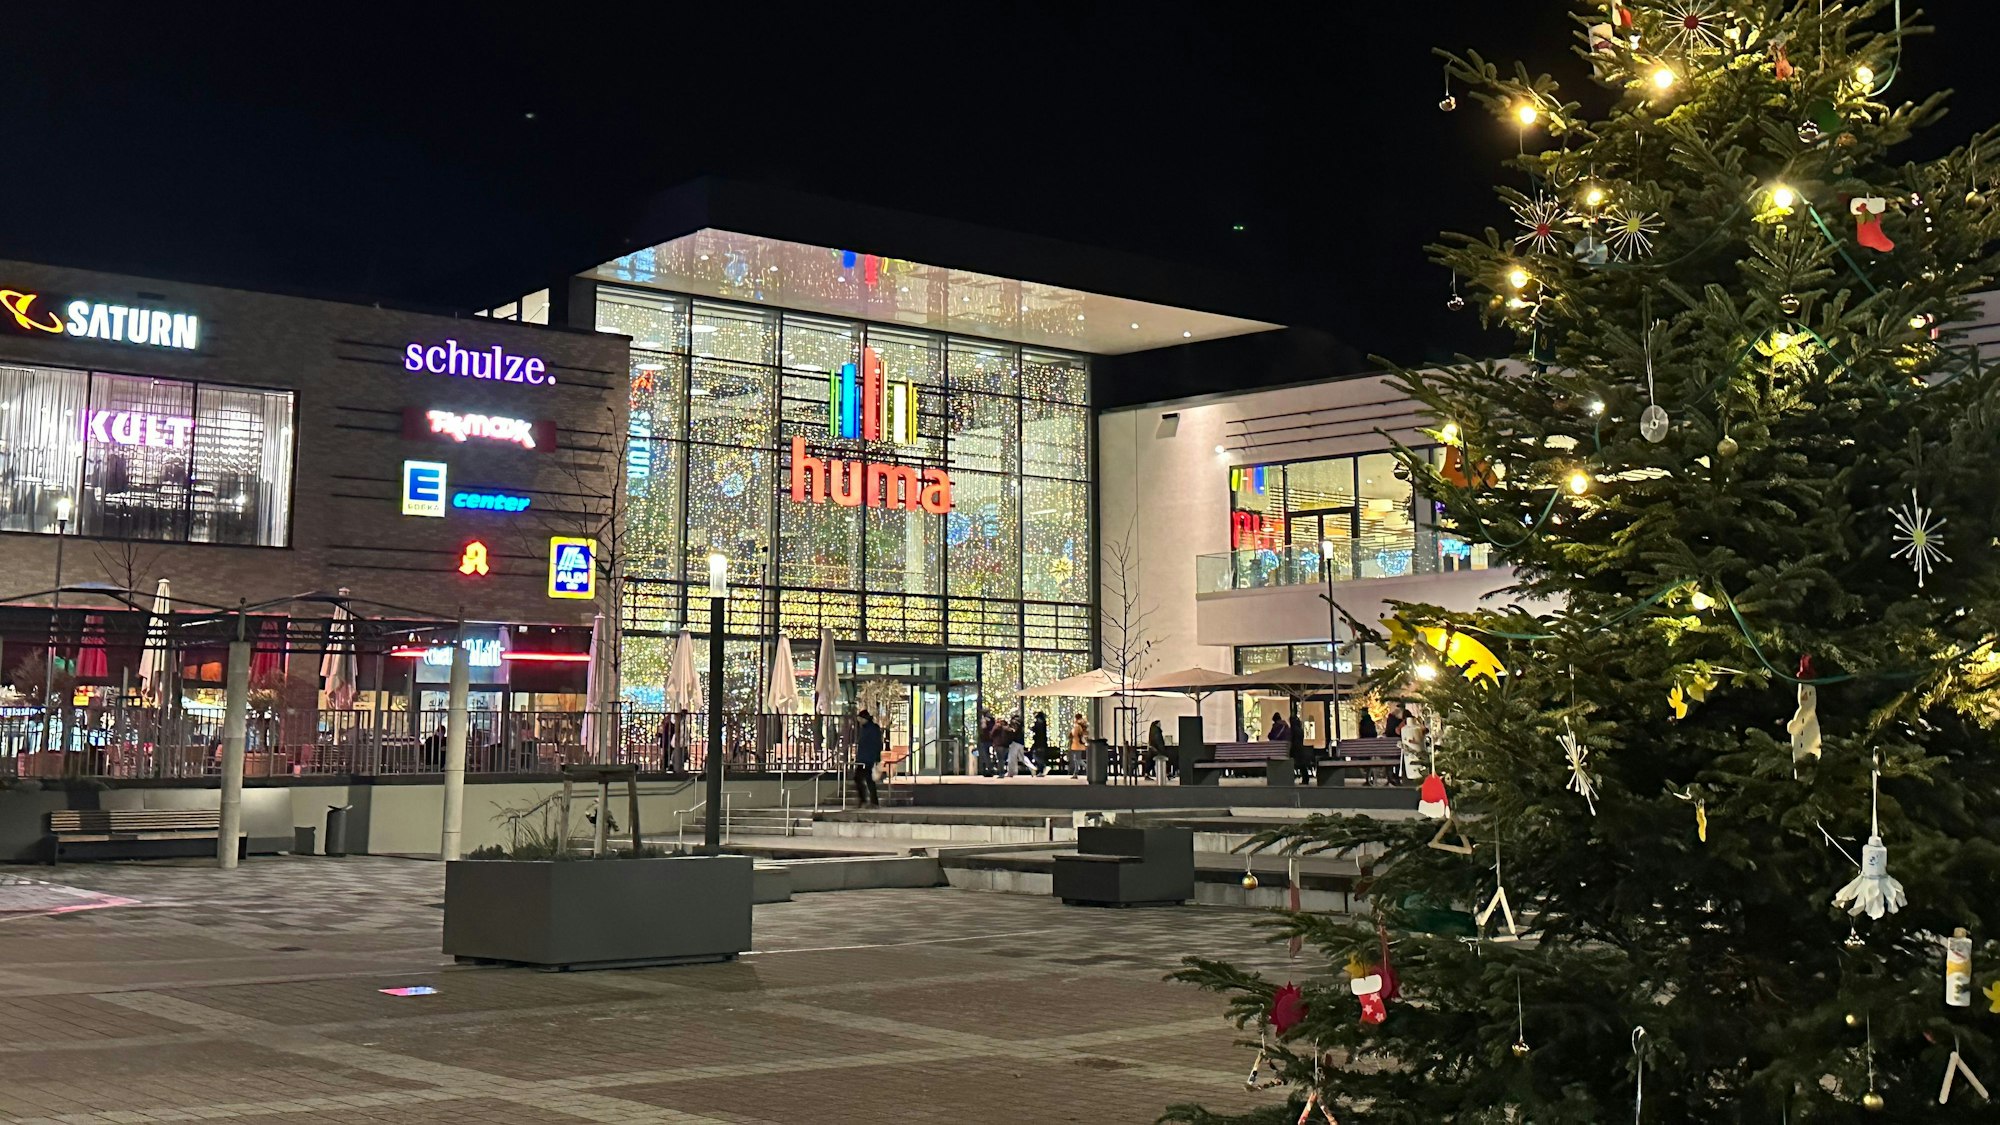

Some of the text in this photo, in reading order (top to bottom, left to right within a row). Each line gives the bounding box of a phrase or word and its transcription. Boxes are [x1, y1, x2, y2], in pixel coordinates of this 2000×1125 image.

[66, 300, 199, 350] SATURN
[404, 340, 558, 385] schulze.
[84, 408, 195, 449] KULT
[790, 435, 952, 515] huma
[451, 491, 531, 512] center
[556, 570, 588, 584] ALDI
